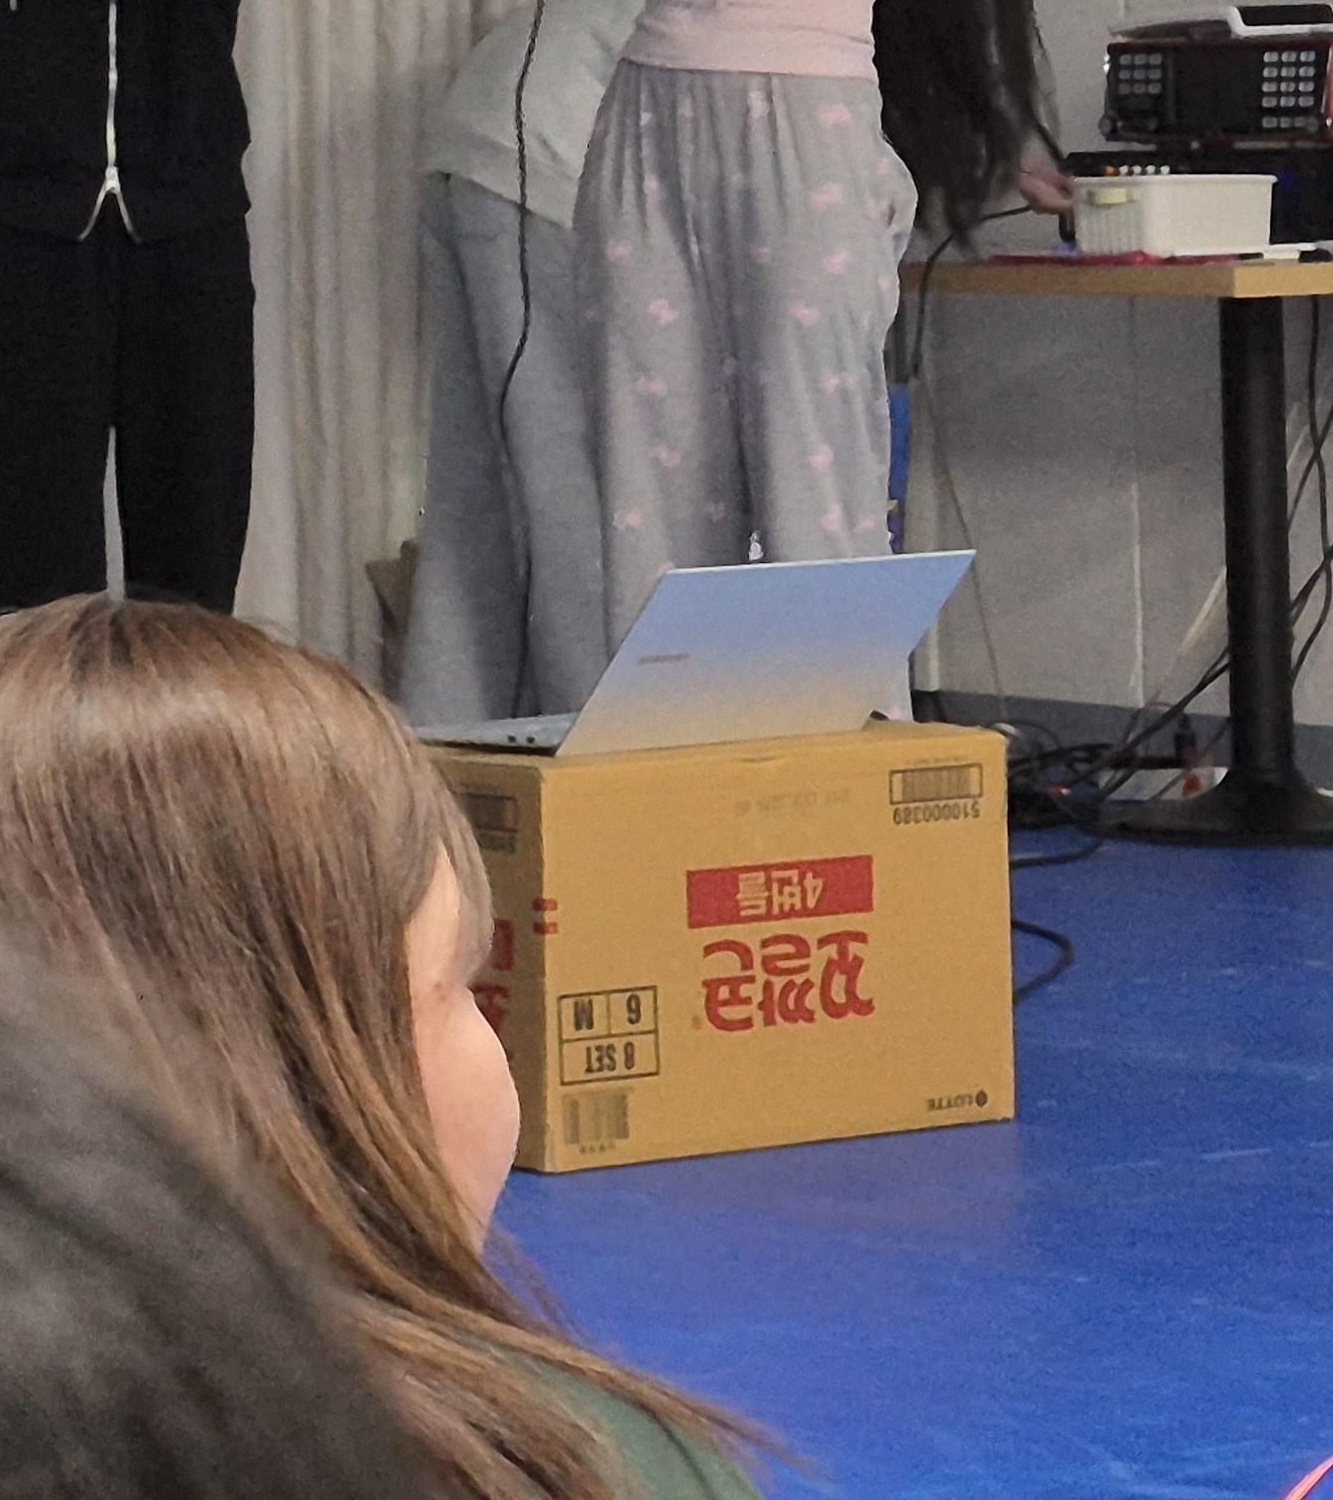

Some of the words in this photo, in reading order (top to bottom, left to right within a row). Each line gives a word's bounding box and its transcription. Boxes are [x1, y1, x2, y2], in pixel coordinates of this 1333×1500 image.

[735, 868, 824, 918] 4번들
[702, 929, 876, 1033] 꼬깔콘
[584, 1043, 616, 1075] SET
